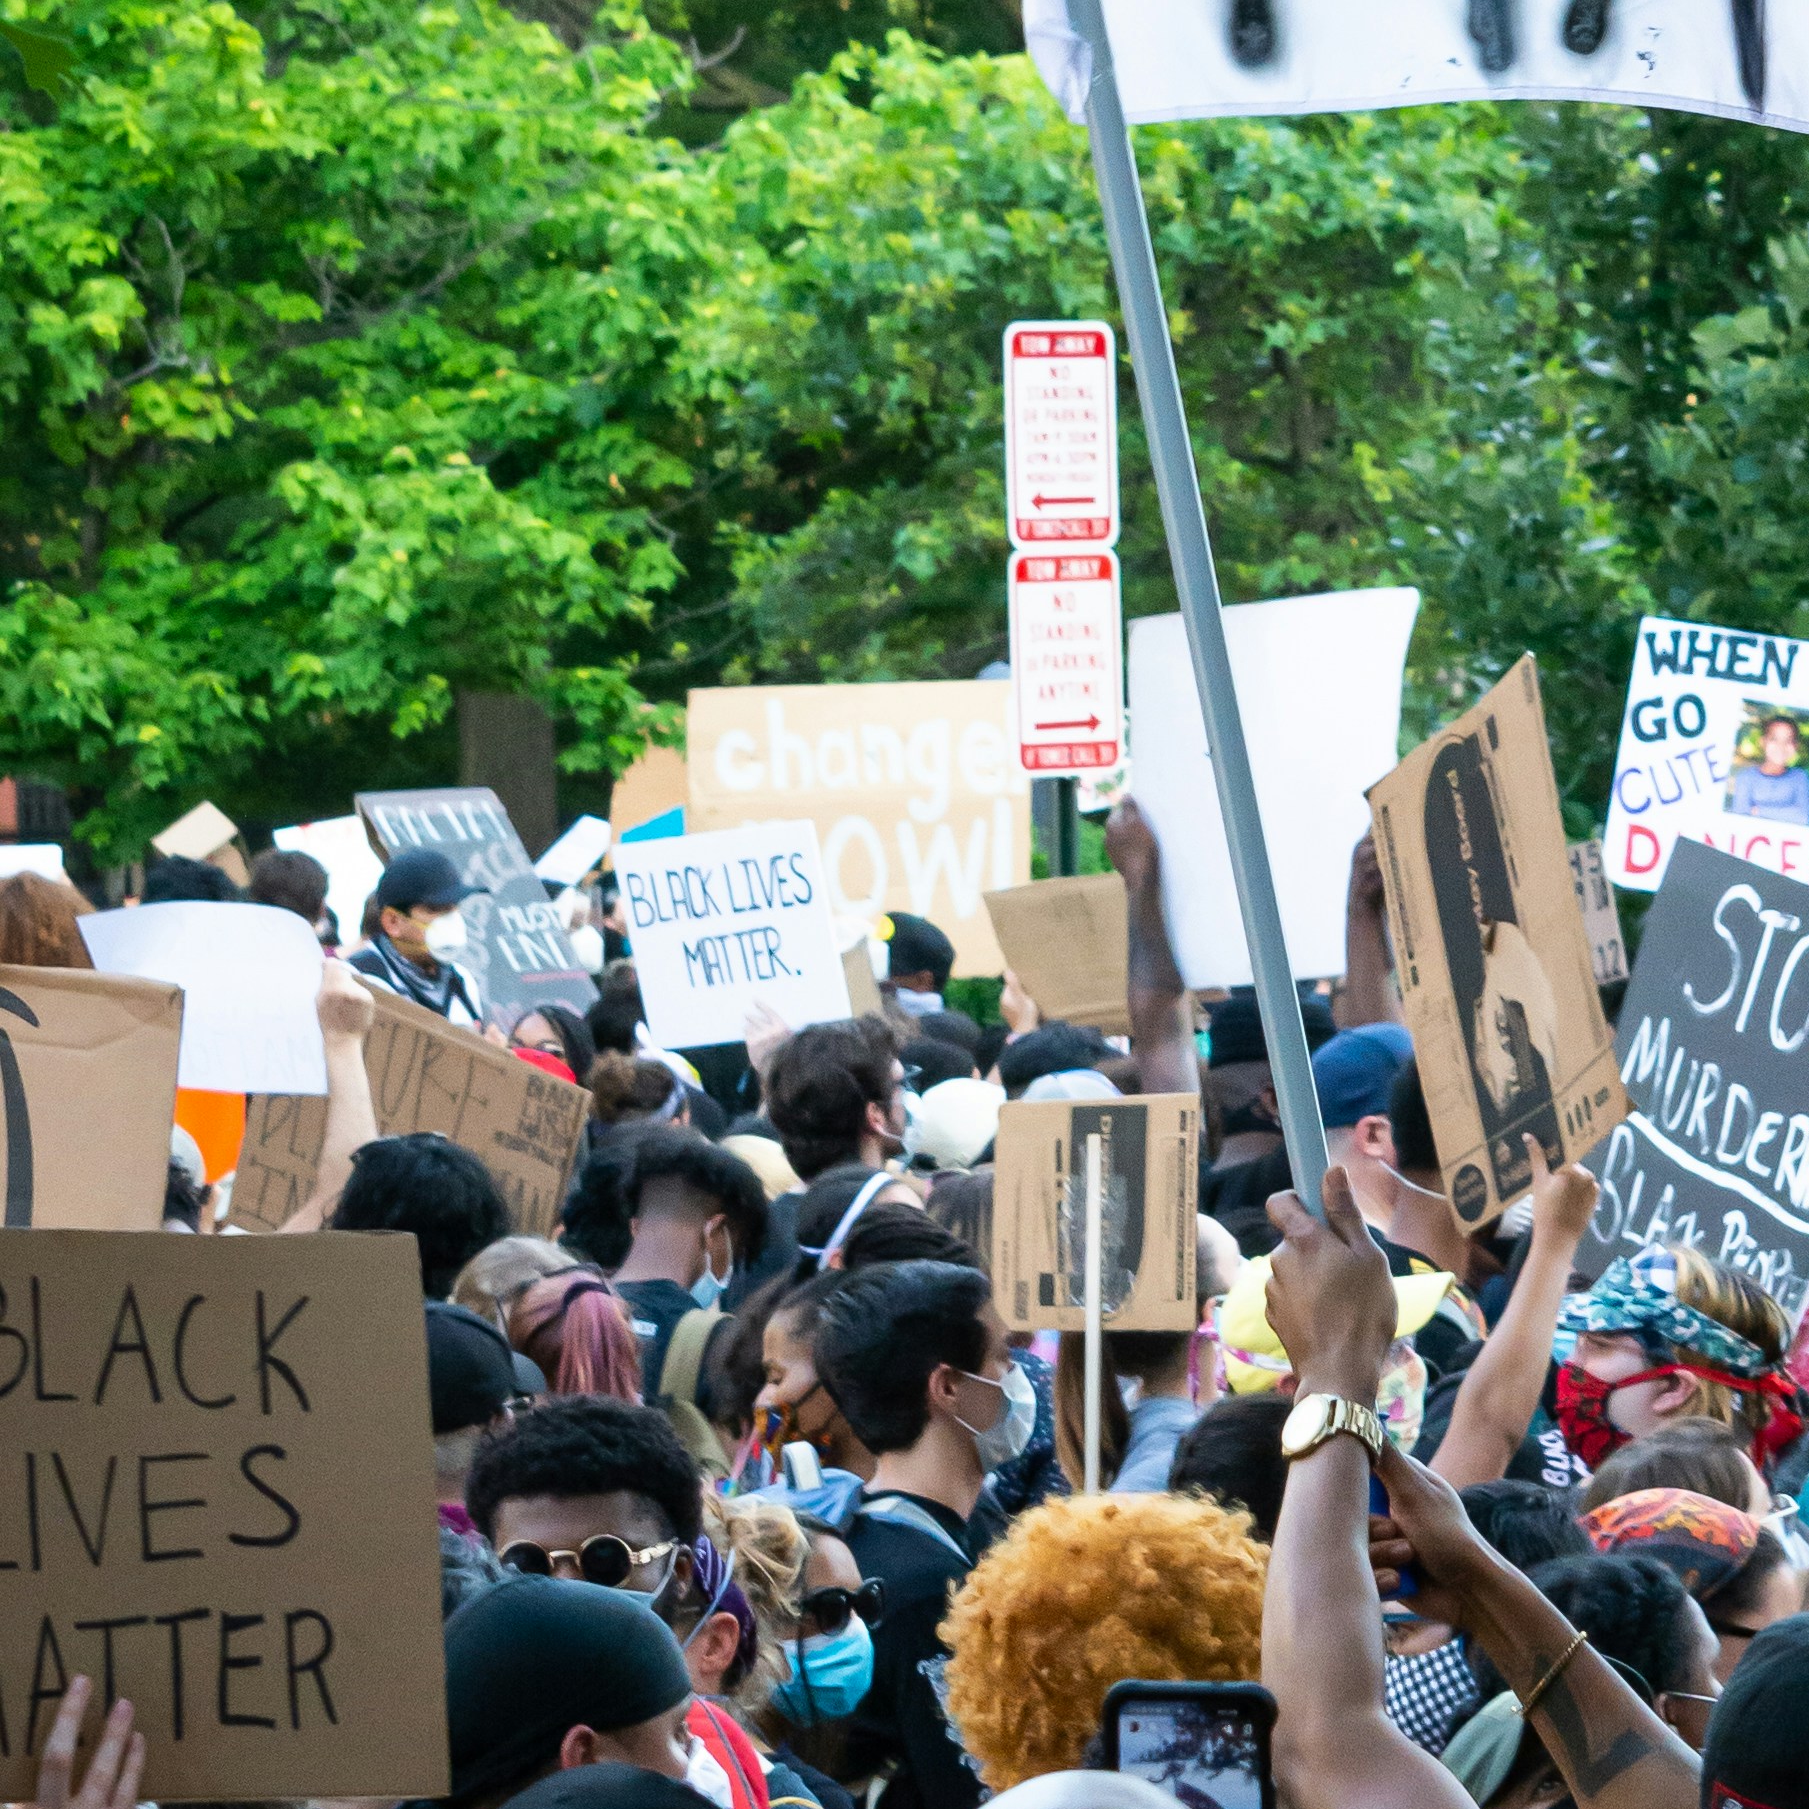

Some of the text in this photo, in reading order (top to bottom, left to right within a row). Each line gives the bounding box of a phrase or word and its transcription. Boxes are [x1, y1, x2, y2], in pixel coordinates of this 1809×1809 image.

[1053, 593, 1076, 612] NO
[1645, 629, 1799, 688] WHEN
[1630, 693, 1707, 743] GO
[714, 697, 1010, 823] change
[1615, 744, 1730, 815] CUTE
[626, 851, 813, 929] BLACK LIVES
[682, 925, 802, 989] MATTER.
[0, 1443, 302, 1572] IVES
[0, 1607, 340, 1759] ATTER
